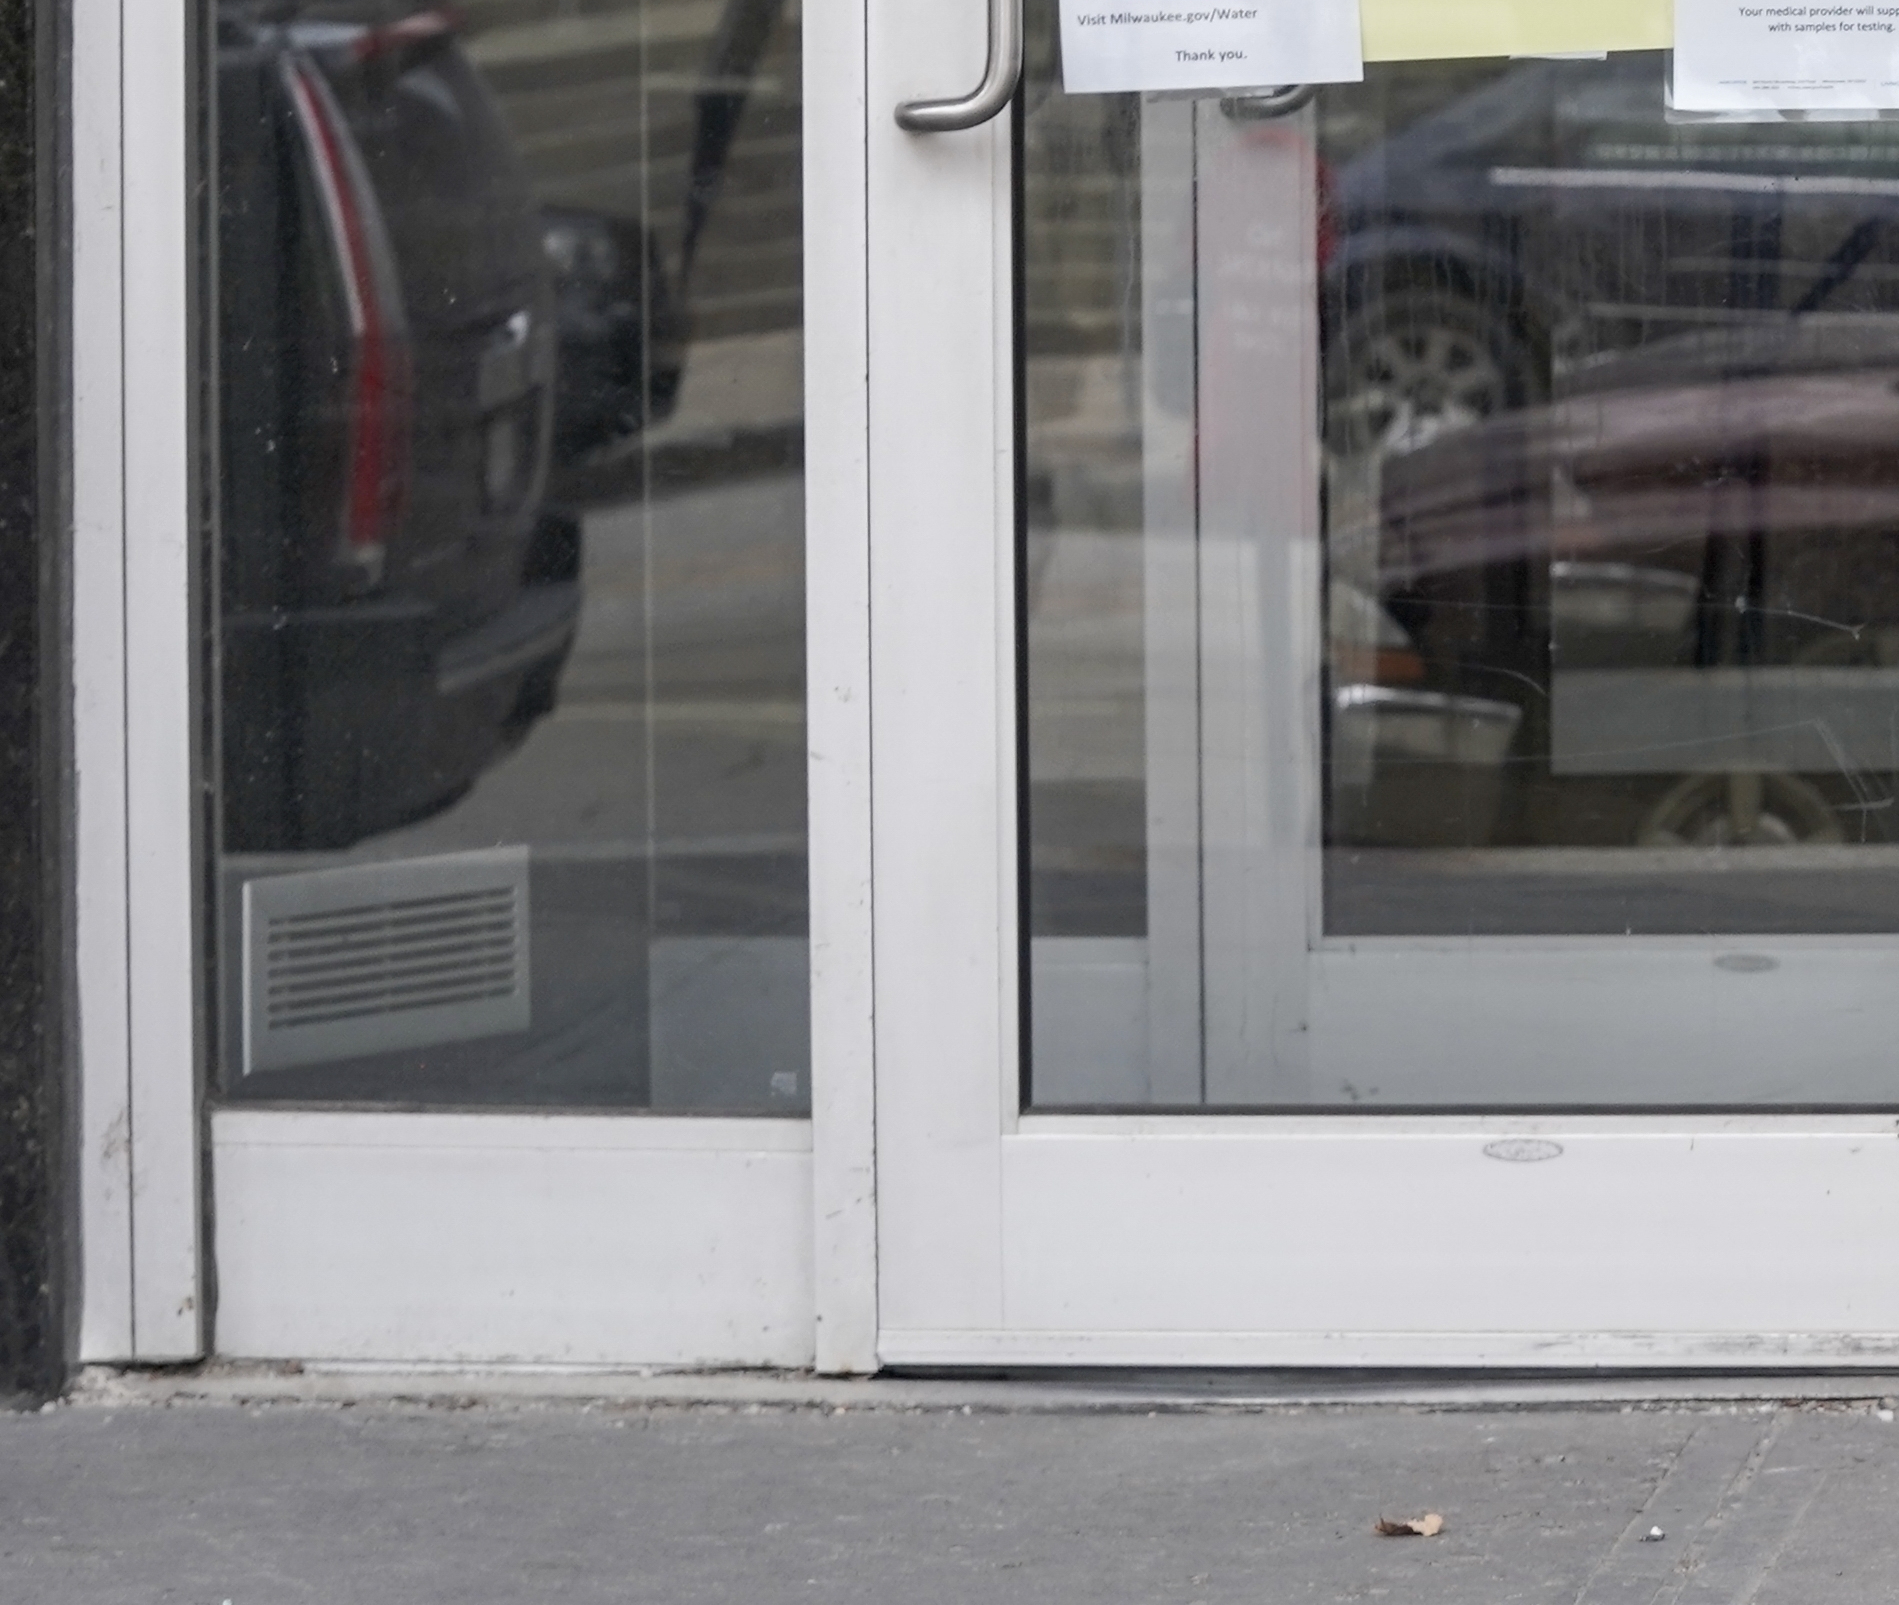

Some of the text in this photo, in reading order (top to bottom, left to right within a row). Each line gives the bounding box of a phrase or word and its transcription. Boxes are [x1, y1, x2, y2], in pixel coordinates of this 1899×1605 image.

[1077, 7, 1258, 25] Visit Milwaukee.gov/Water
[1176, 49, 1247, 62] Thank you.
